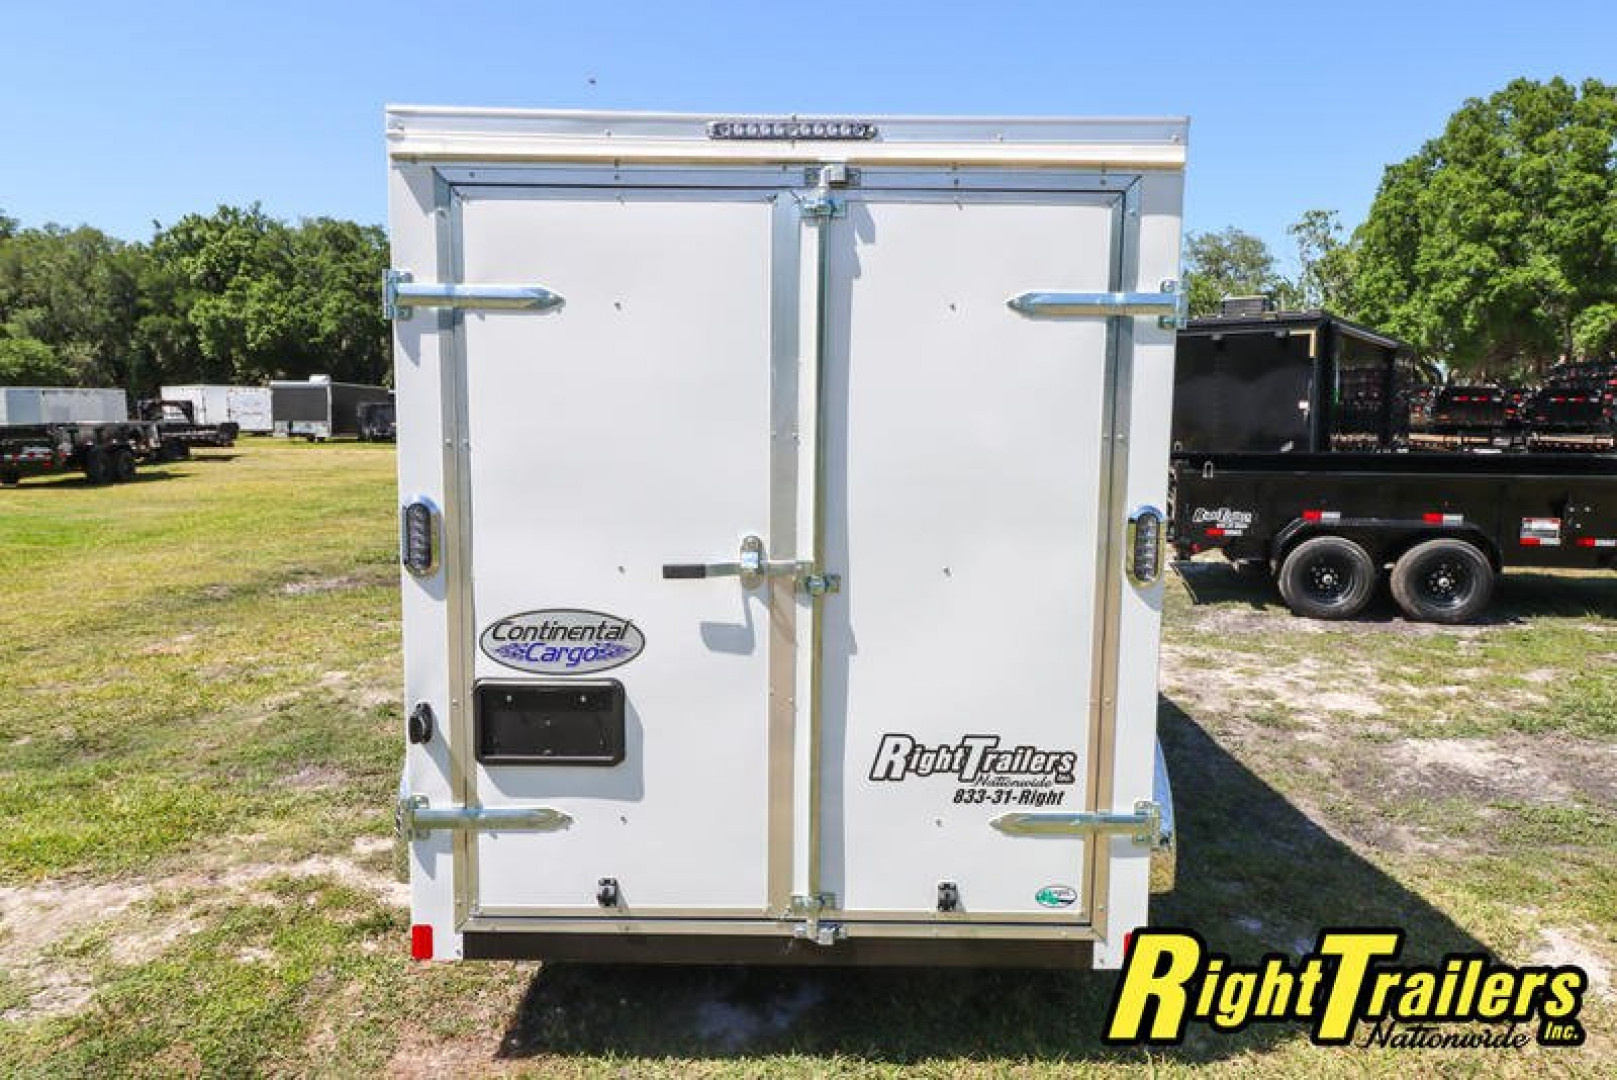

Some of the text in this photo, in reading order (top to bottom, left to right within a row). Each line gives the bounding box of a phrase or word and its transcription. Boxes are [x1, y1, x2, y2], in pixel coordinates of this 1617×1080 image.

[492, 620, 630, 642] Continental
[525, 643, 600, 667] Cargo
[953, 788, 1066, 807] 833-31-Right
